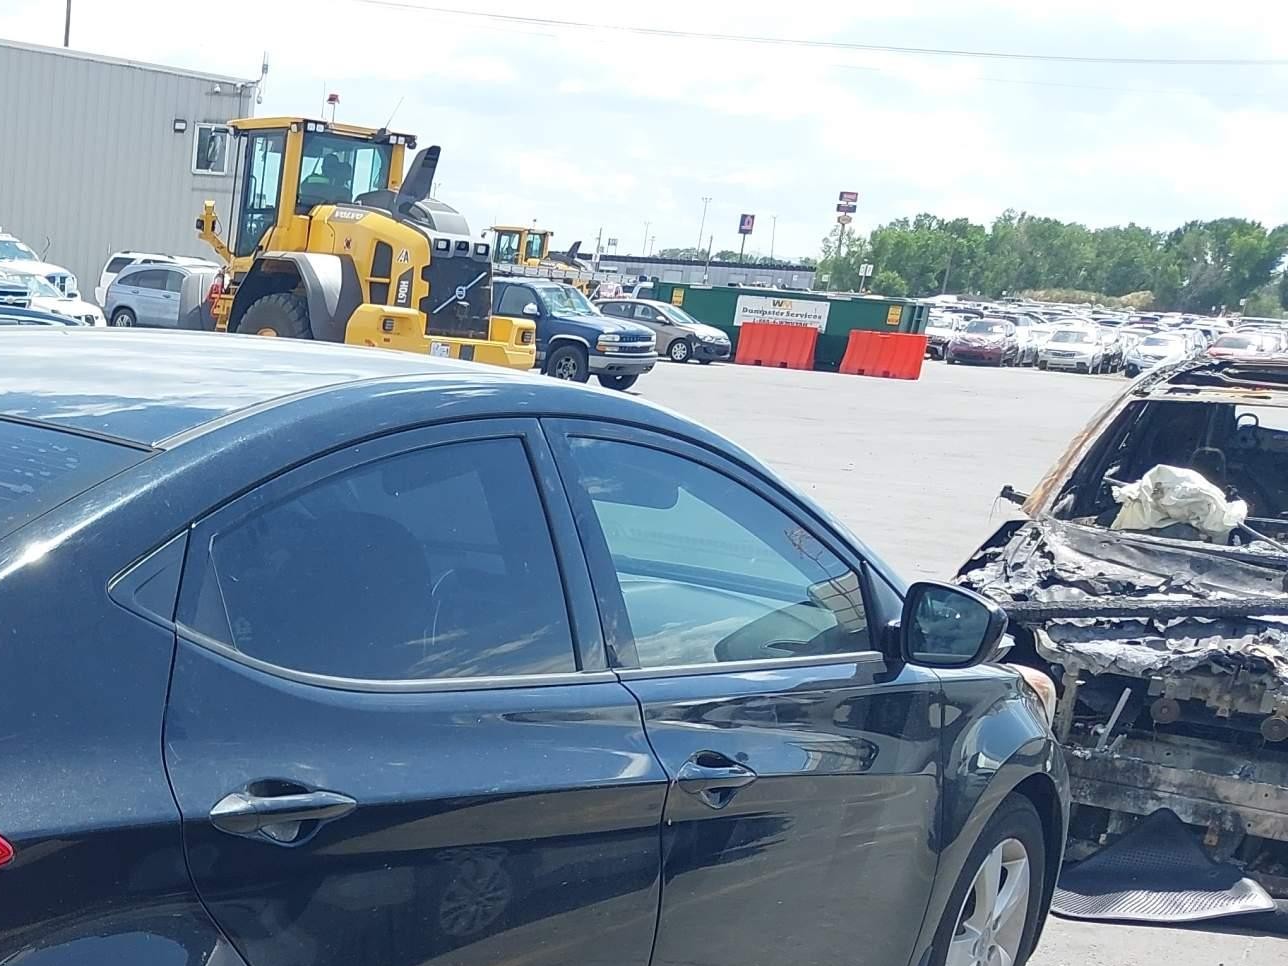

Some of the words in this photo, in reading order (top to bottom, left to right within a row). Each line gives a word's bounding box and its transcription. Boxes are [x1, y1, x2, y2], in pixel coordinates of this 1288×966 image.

[334, 210, 365, 221] VOLVO
[397, 280, 410, 304] L90H
[772, 299, 793, 310] WM
[741, 306, 785, 317] Dumpster
[786, 311, 822, 321] Services
